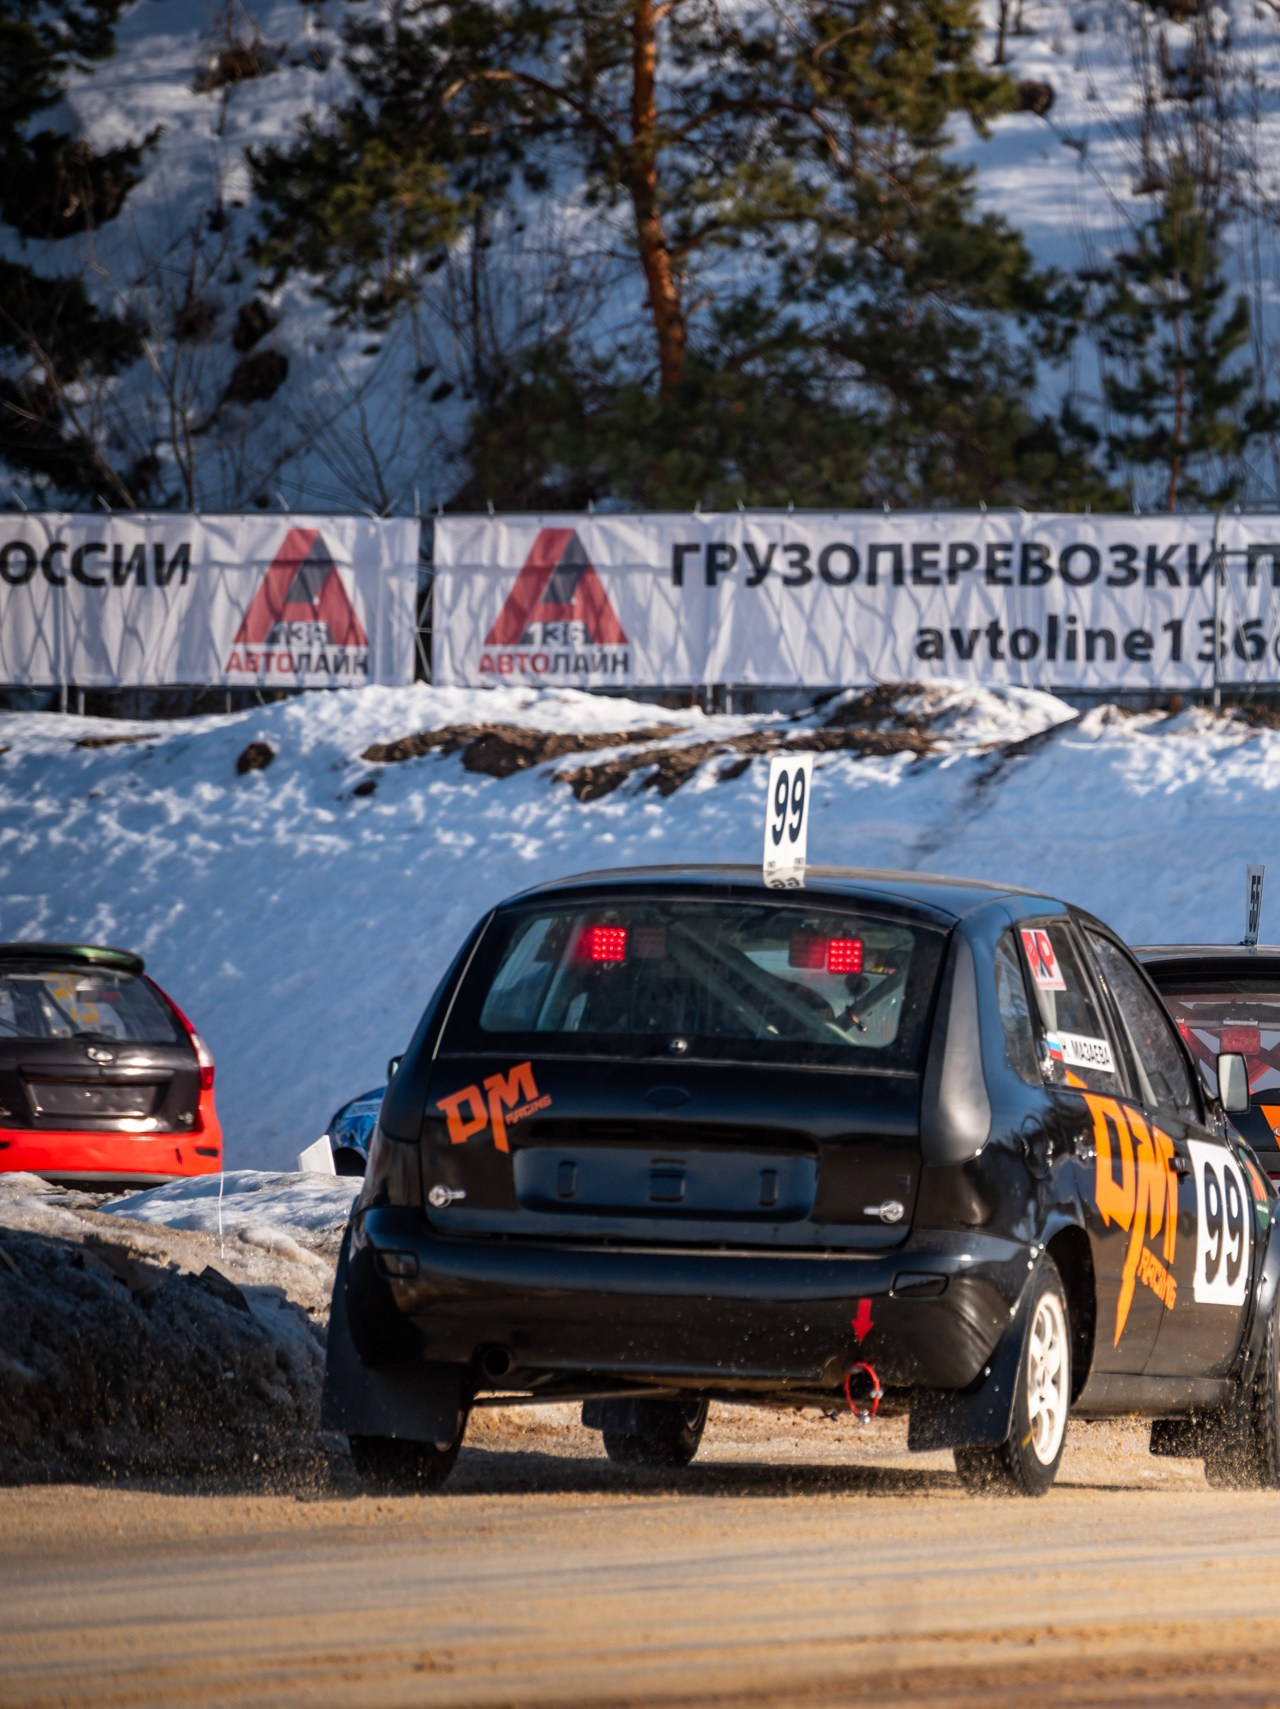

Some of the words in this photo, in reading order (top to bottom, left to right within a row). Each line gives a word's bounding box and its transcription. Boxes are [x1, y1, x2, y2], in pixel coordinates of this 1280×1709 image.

[0, 540, 192, 588] ОССИИ
[671, 541, 1226, 588] ГРУЗОПЕРЕВОЗКИ
[527, 621, 587, 647] 136
[225, 649, 370, 674] АВТОЛАЙН
[477, 649, 630, 674] АВТОЛАЙН
[771, 766, 807, 846] 99
[1204, 1161, 1245, 1287] 99
[1136, 1246, 1178, 1311] RACING
